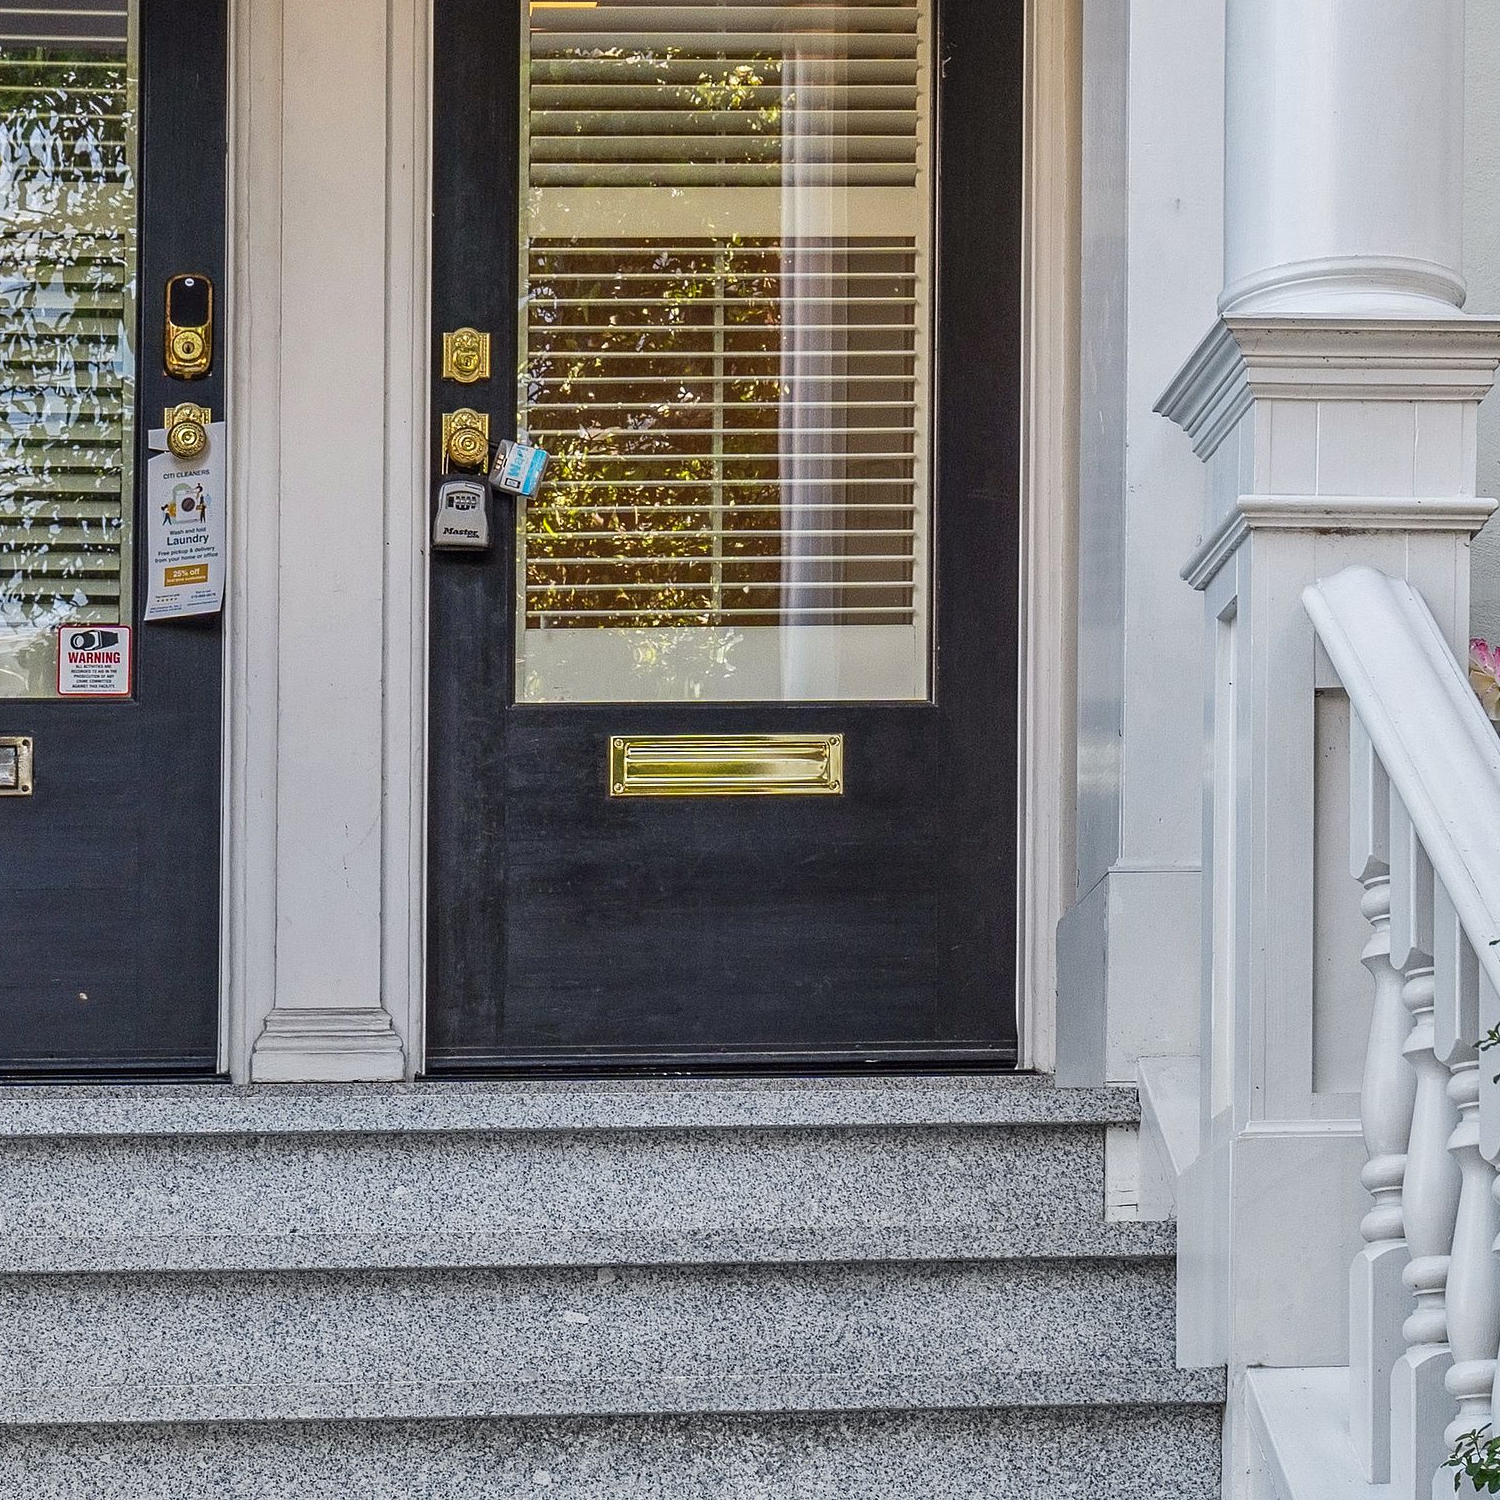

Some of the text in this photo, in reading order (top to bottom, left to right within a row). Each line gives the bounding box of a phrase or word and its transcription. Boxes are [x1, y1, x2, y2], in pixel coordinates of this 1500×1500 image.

[176, 469, 210, 478] CLEANERS
[442, 527, 479, 536] Master
[167, 533, 209, 546] Laundry
[173, 570, 188, 578] 25%
[68, 652, 121, 664] WARNING
